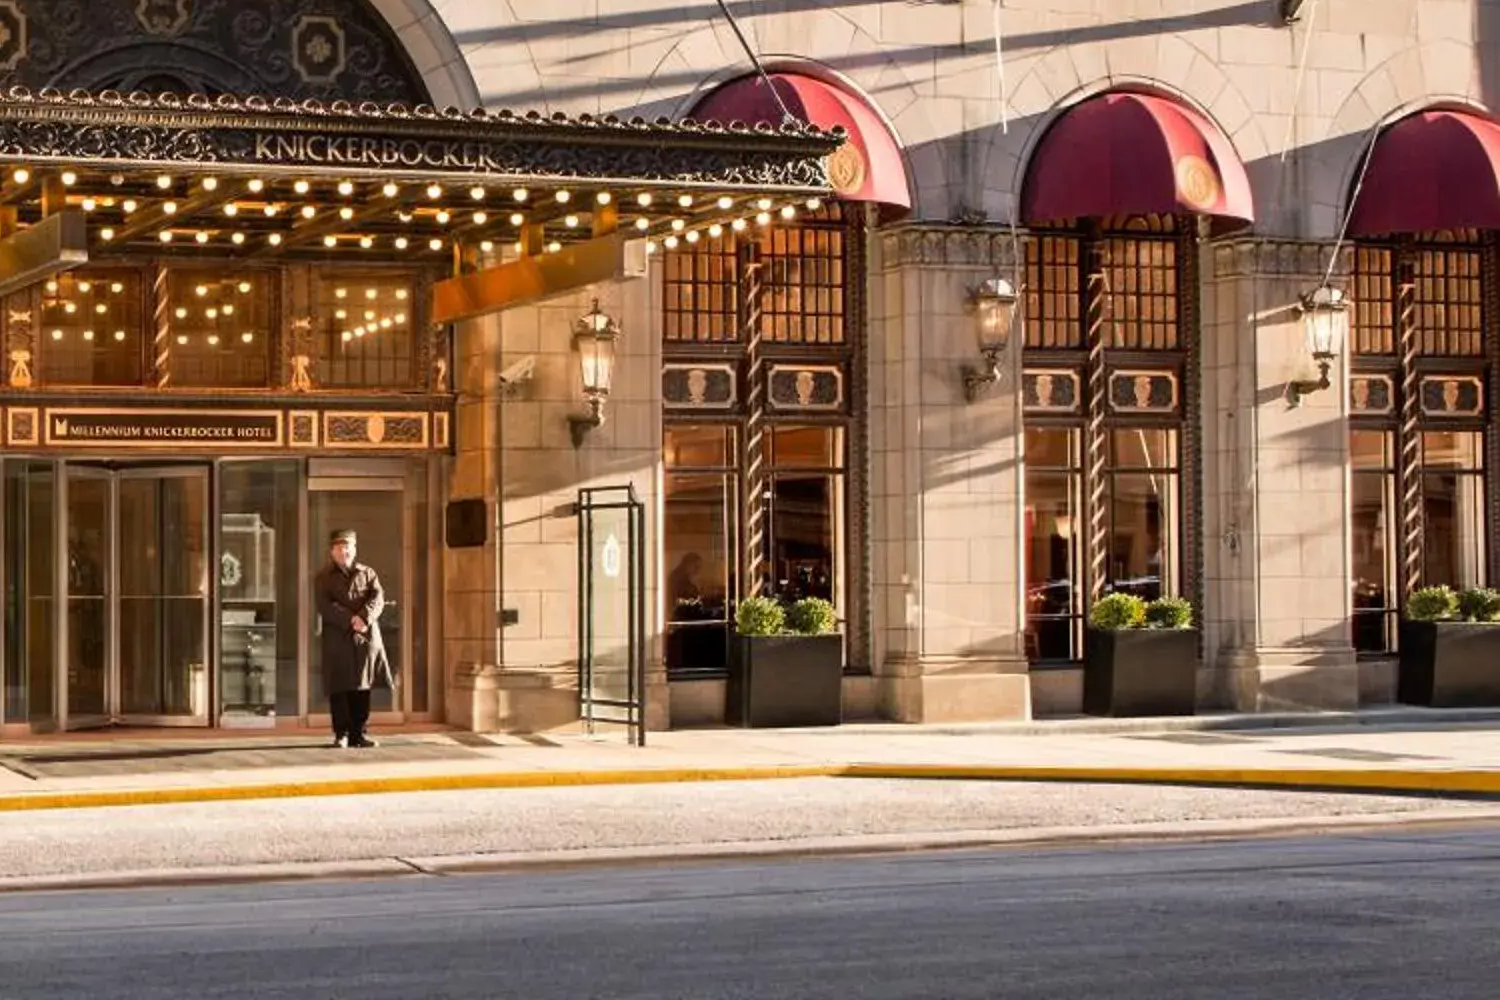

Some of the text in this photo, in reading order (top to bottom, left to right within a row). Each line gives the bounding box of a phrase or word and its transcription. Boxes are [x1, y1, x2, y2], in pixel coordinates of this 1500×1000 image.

[255, 133, 500, 168] KNICKERBOCKER
[70, 425, 273, 438] MILLENNIUM KNICKERBOCKER HOTEL
